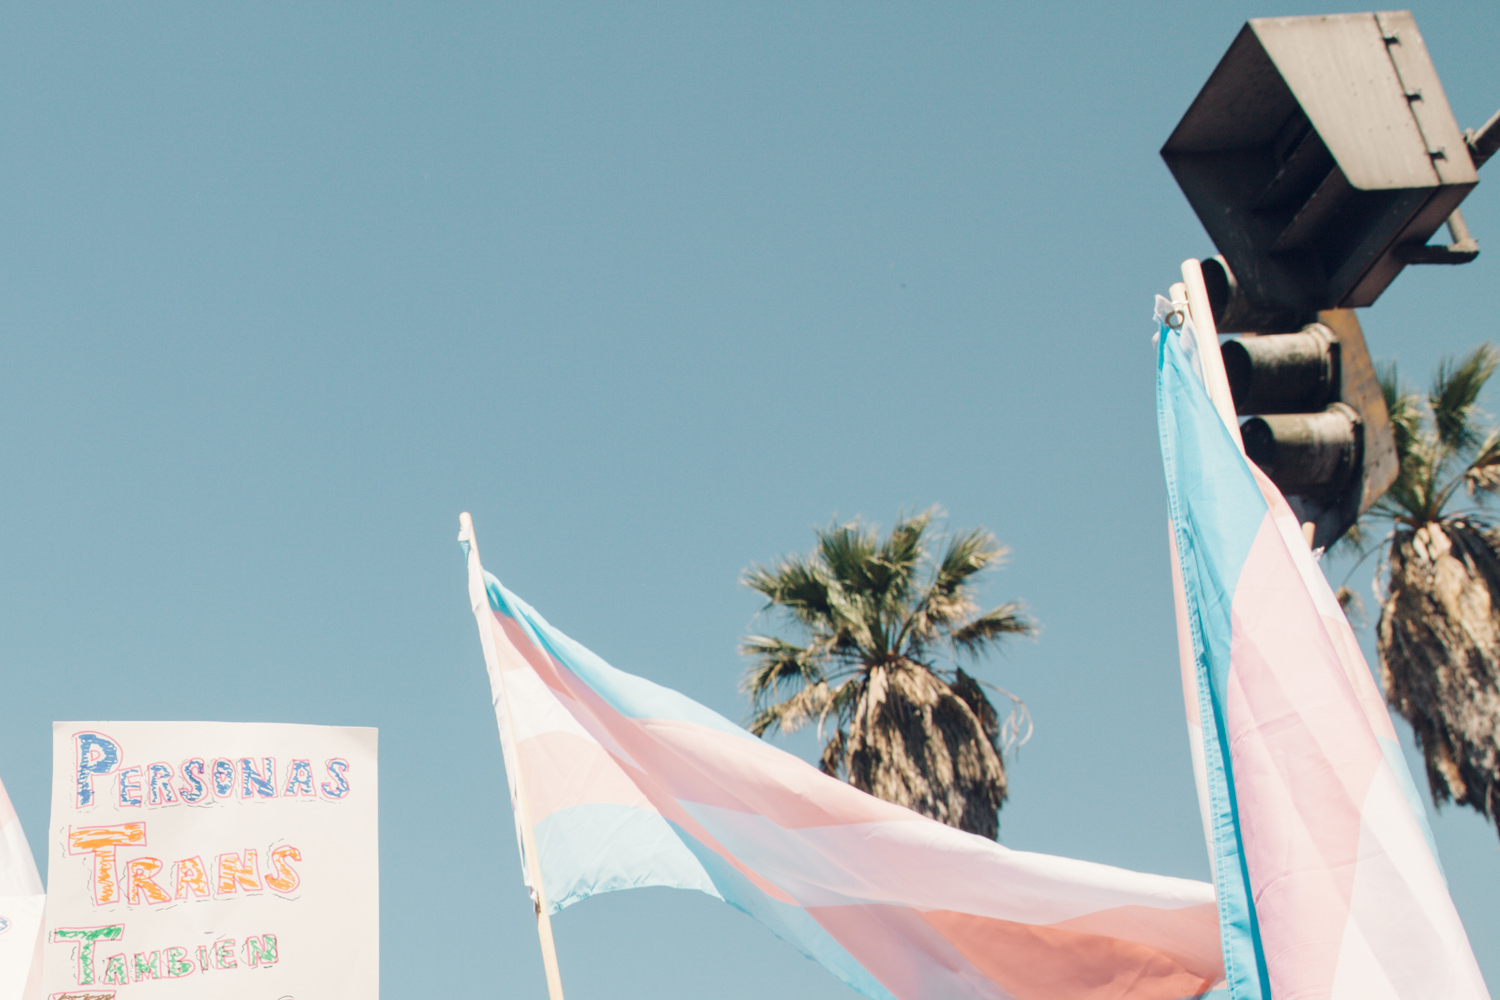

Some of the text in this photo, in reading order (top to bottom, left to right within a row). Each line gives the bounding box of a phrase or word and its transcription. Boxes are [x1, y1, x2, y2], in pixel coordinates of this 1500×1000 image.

[72, 731, 350, 809] PERSONAS
[68, 821, 302, 906] TRANS
[54, 924, 278, 985] TAMBIEN
